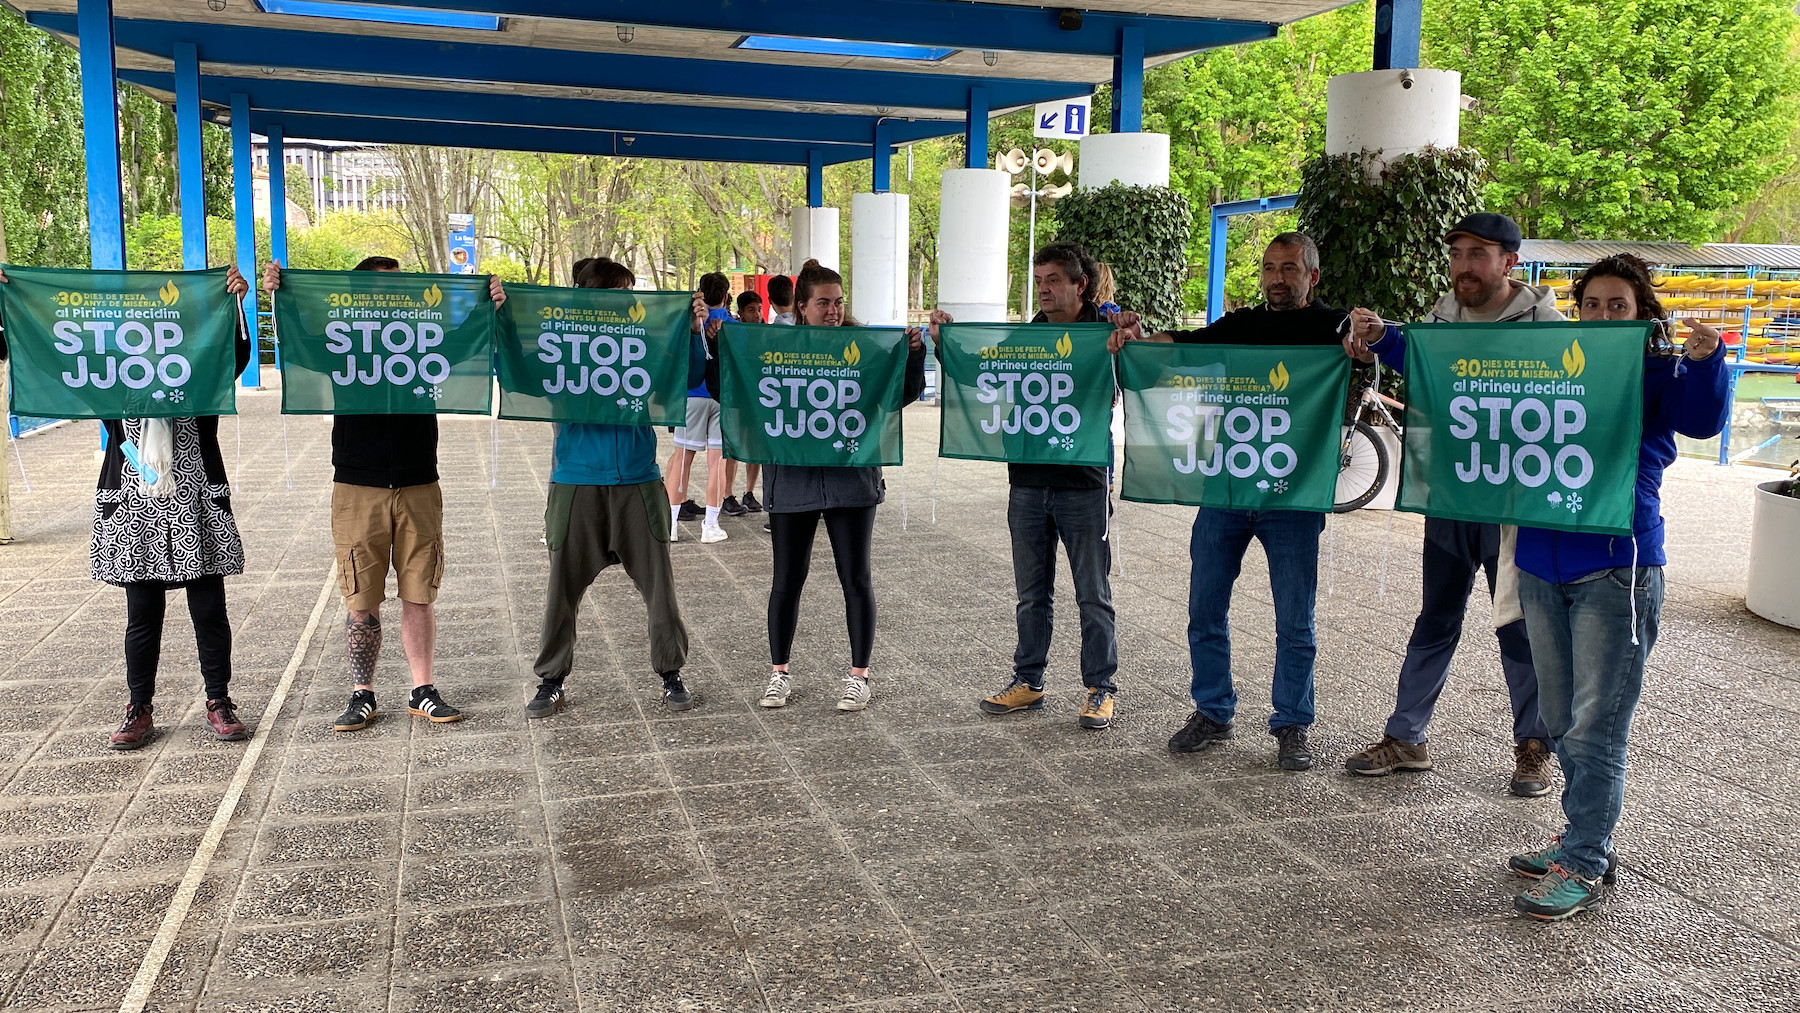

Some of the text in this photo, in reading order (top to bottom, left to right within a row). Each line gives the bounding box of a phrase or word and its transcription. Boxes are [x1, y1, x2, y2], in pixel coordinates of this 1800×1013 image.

[58, 292, 82, 305] 30
[330, 293, 352, 306] 30
[55, 307, 180, 319] al Pirineu decidim
[328, 308, 442, 320] al Pirineu decidim
[544, 307, 563, 319] 30
[541, 321, 645, 335] al Pirineu decidim
[53, 321, 183, 355] STOP
[325, 321, 444, 353] STOP
[538, 333, 646, 366] STOP
[764, 352, 783, 364] 30
[981, 346, 998, 359] 30
[62, 354, 191, 389] JJOO
[332, 353, 450, 385] JJOO
[762, 366, 860, 377] al Pirineu decidim
[979, 361, 1072, 370] al Pirineu decidim
[1457, 359, 1480, 377] 30
[1483, 360, 1501, 368] DIES
[543, 365, 651, 396] JJOO
[1174, 375, 1195, 389] 30
[1481, 369, 1504, 377] ANYS
[1508, 370, 1518, 378] DE
[759, 377, 861, 409] STOP
[976, 373, 1074, 404] STOP
[1453, 379, 1585, 395] al Pirineu decidim
[1170, 392, 1289, 405] al Pirineu decidim
[765, 409, 866, 439] JJOO
[981, 404, 1080, 435] JJOO
[1167, 405, 1291, 442] STOP
[1450, 396, 1586, 443] STOP
[1173, 443, 1297, 478] JJOO
[1455, 442, 1594, 489] JJOO
